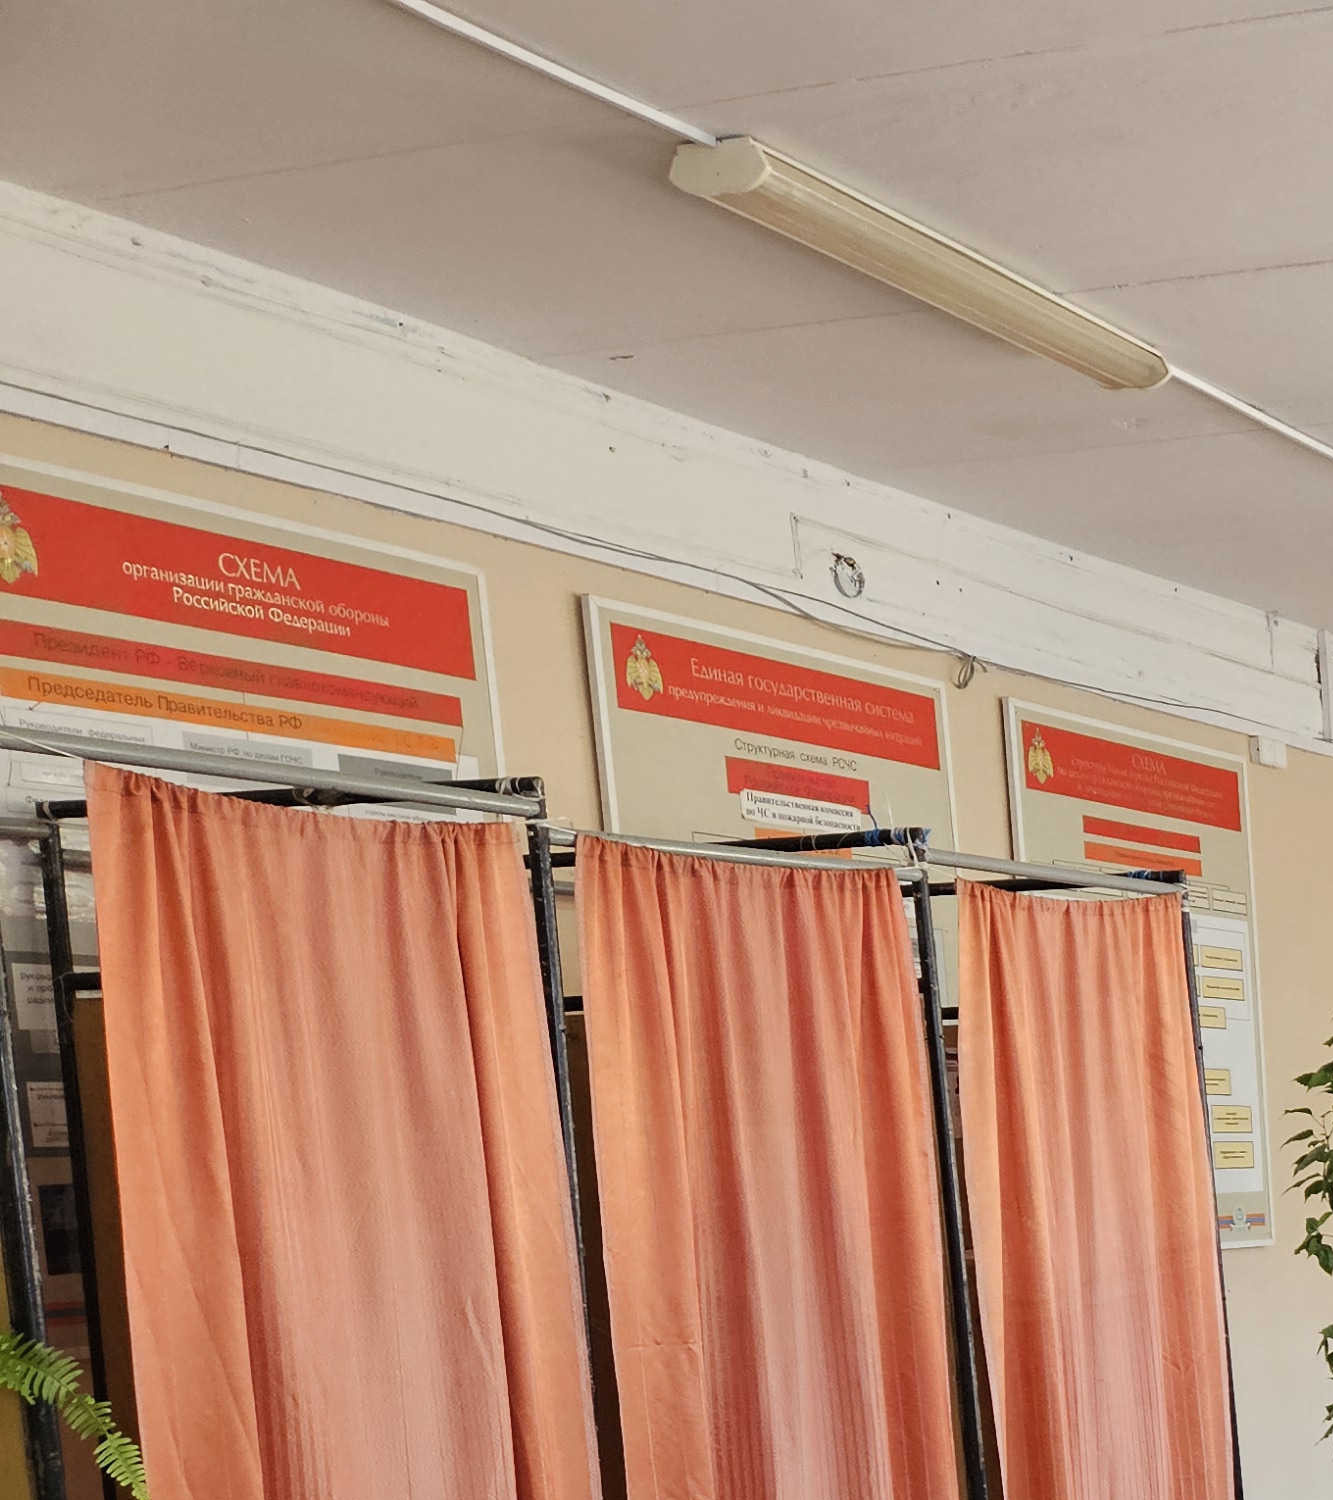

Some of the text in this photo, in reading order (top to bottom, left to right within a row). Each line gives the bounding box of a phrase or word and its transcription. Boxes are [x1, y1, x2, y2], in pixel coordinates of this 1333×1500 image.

[218, 553, 300, 590] СХЕМА
[123, 562, 389, 627] организации гражданской обороны
[173, 587, 350, 636] Российской Федерации
[34, 633, 127, 660] Президент
[135, 649, 161, 665] РФ
[178, 656, 264, 683] Верховный
[27, 676, 302, 730] Председатель Правительства РФ
[668, 685, 755, 712] предупреждения
[757, 703, 764, 713] и
[690, 657, 914, 724] Единая государственная система
[734, 738, 857, 771] Структурная схема РСЧС
[746, 792, 820, 811] Правительственная
[757, 807, 769, 818] ЧС
[779, 813, 813, 825] пожарной
[815, 817, 861, 831] безопасности
